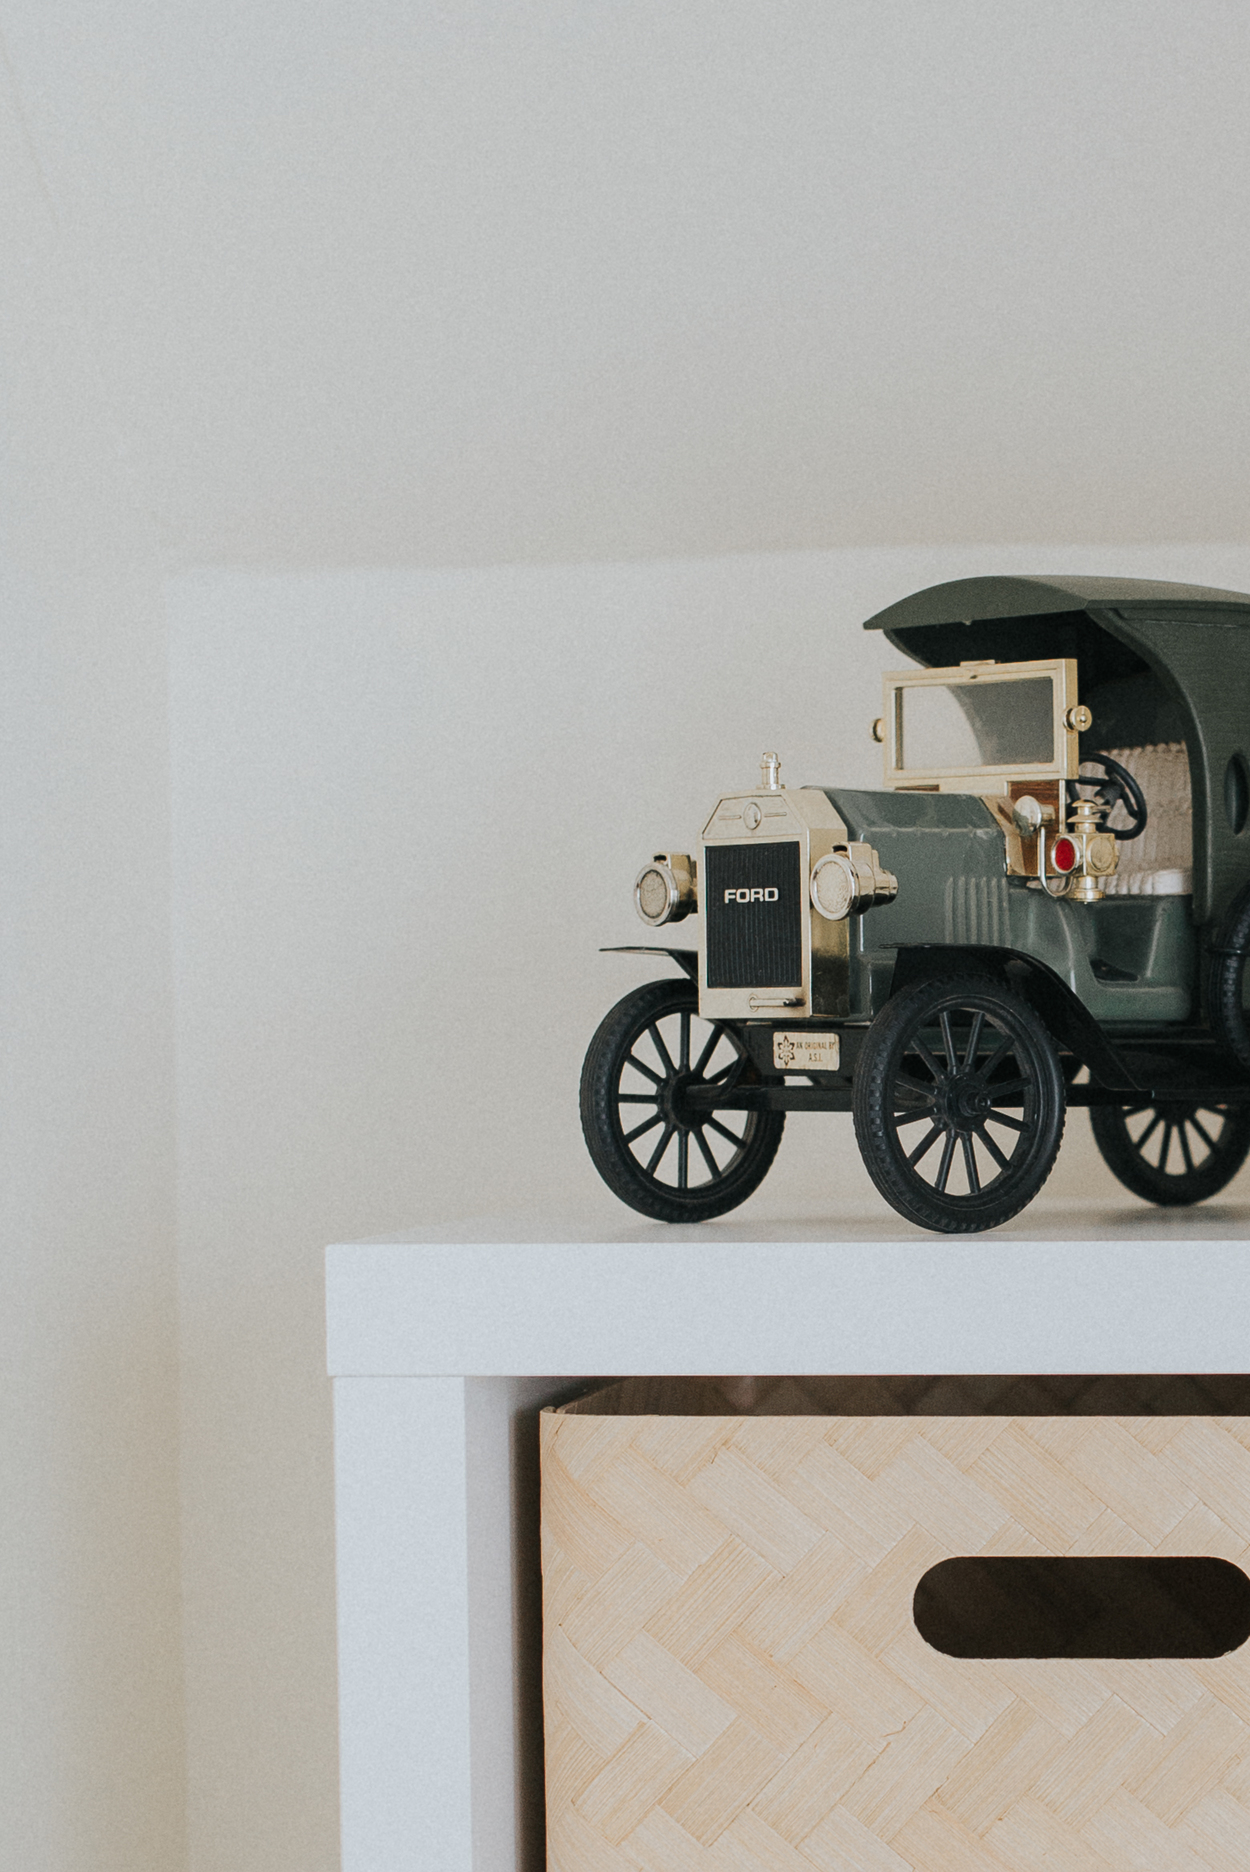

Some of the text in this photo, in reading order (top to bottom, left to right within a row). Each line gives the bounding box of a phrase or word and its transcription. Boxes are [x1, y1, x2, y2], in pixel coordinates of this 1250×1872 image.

[724, 887, 779, 903] FORD
[796, 1041, 803, 1050] AN
[804, 1041, 827, 1050] ORIGINAL
